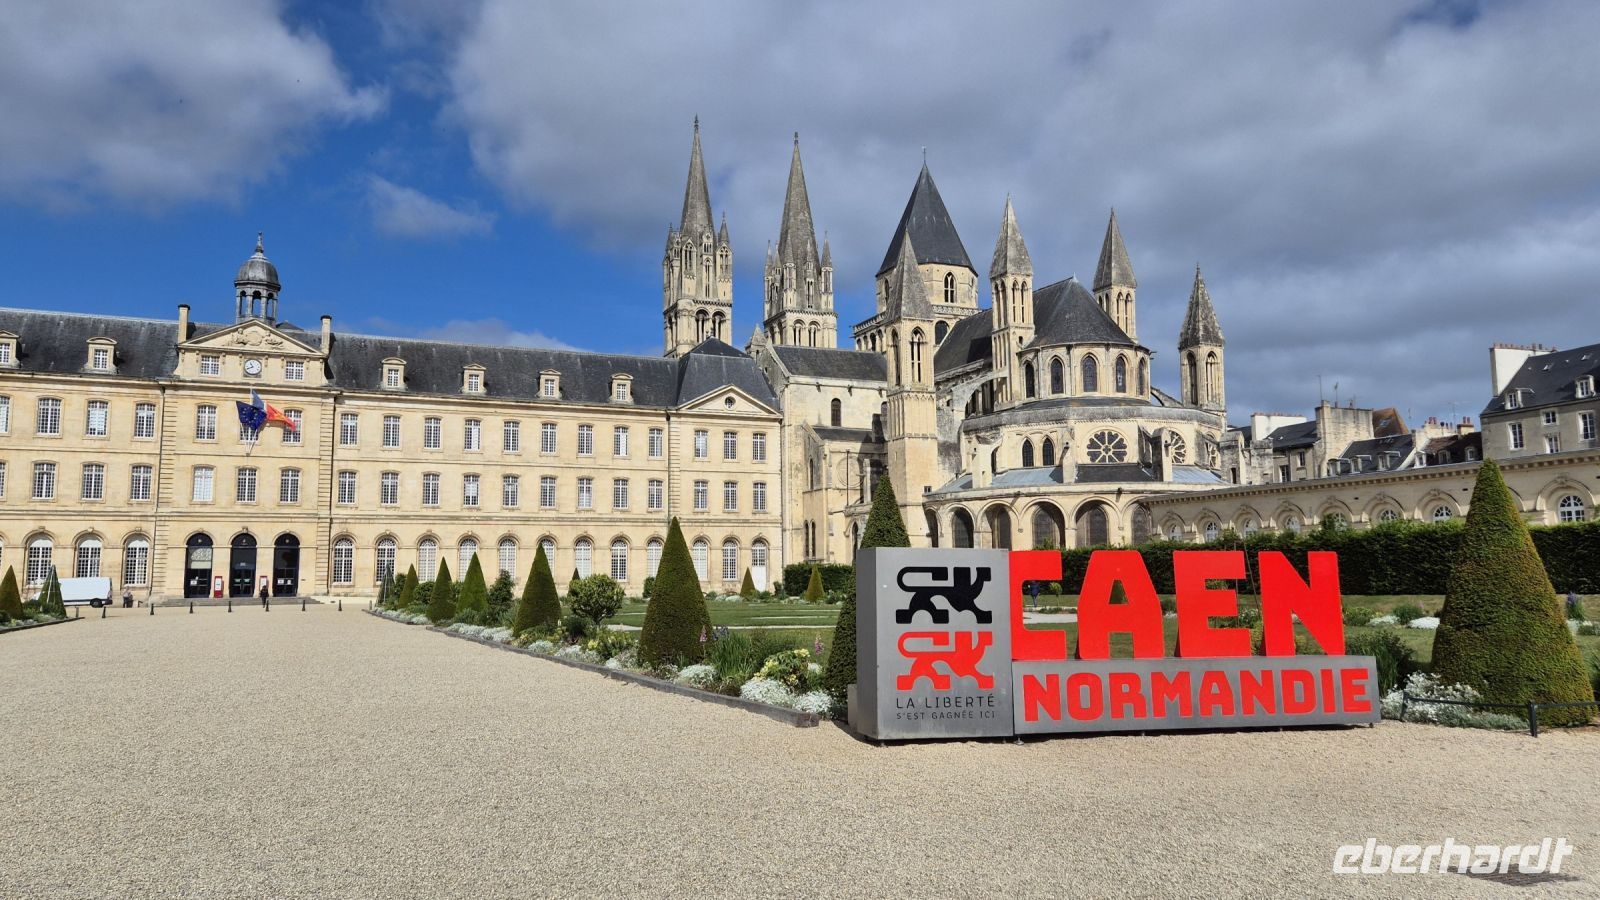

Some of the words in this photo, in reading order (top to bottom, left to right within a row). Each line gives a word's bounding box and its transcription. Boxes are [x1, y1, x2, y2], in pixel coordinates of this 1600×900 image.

[1009, 550, 1345, 661] CAEN
[896, 697, 915, 709] LA
[925, 694, 995, 709] LIBERTÉ
[1023, 668, 1372, 722] NORMANDIE
[896, 712, 925, 720] S'EST
[931, 711, 974, 720] GAGNÉE
[980, 711, 995, 719] ICI
